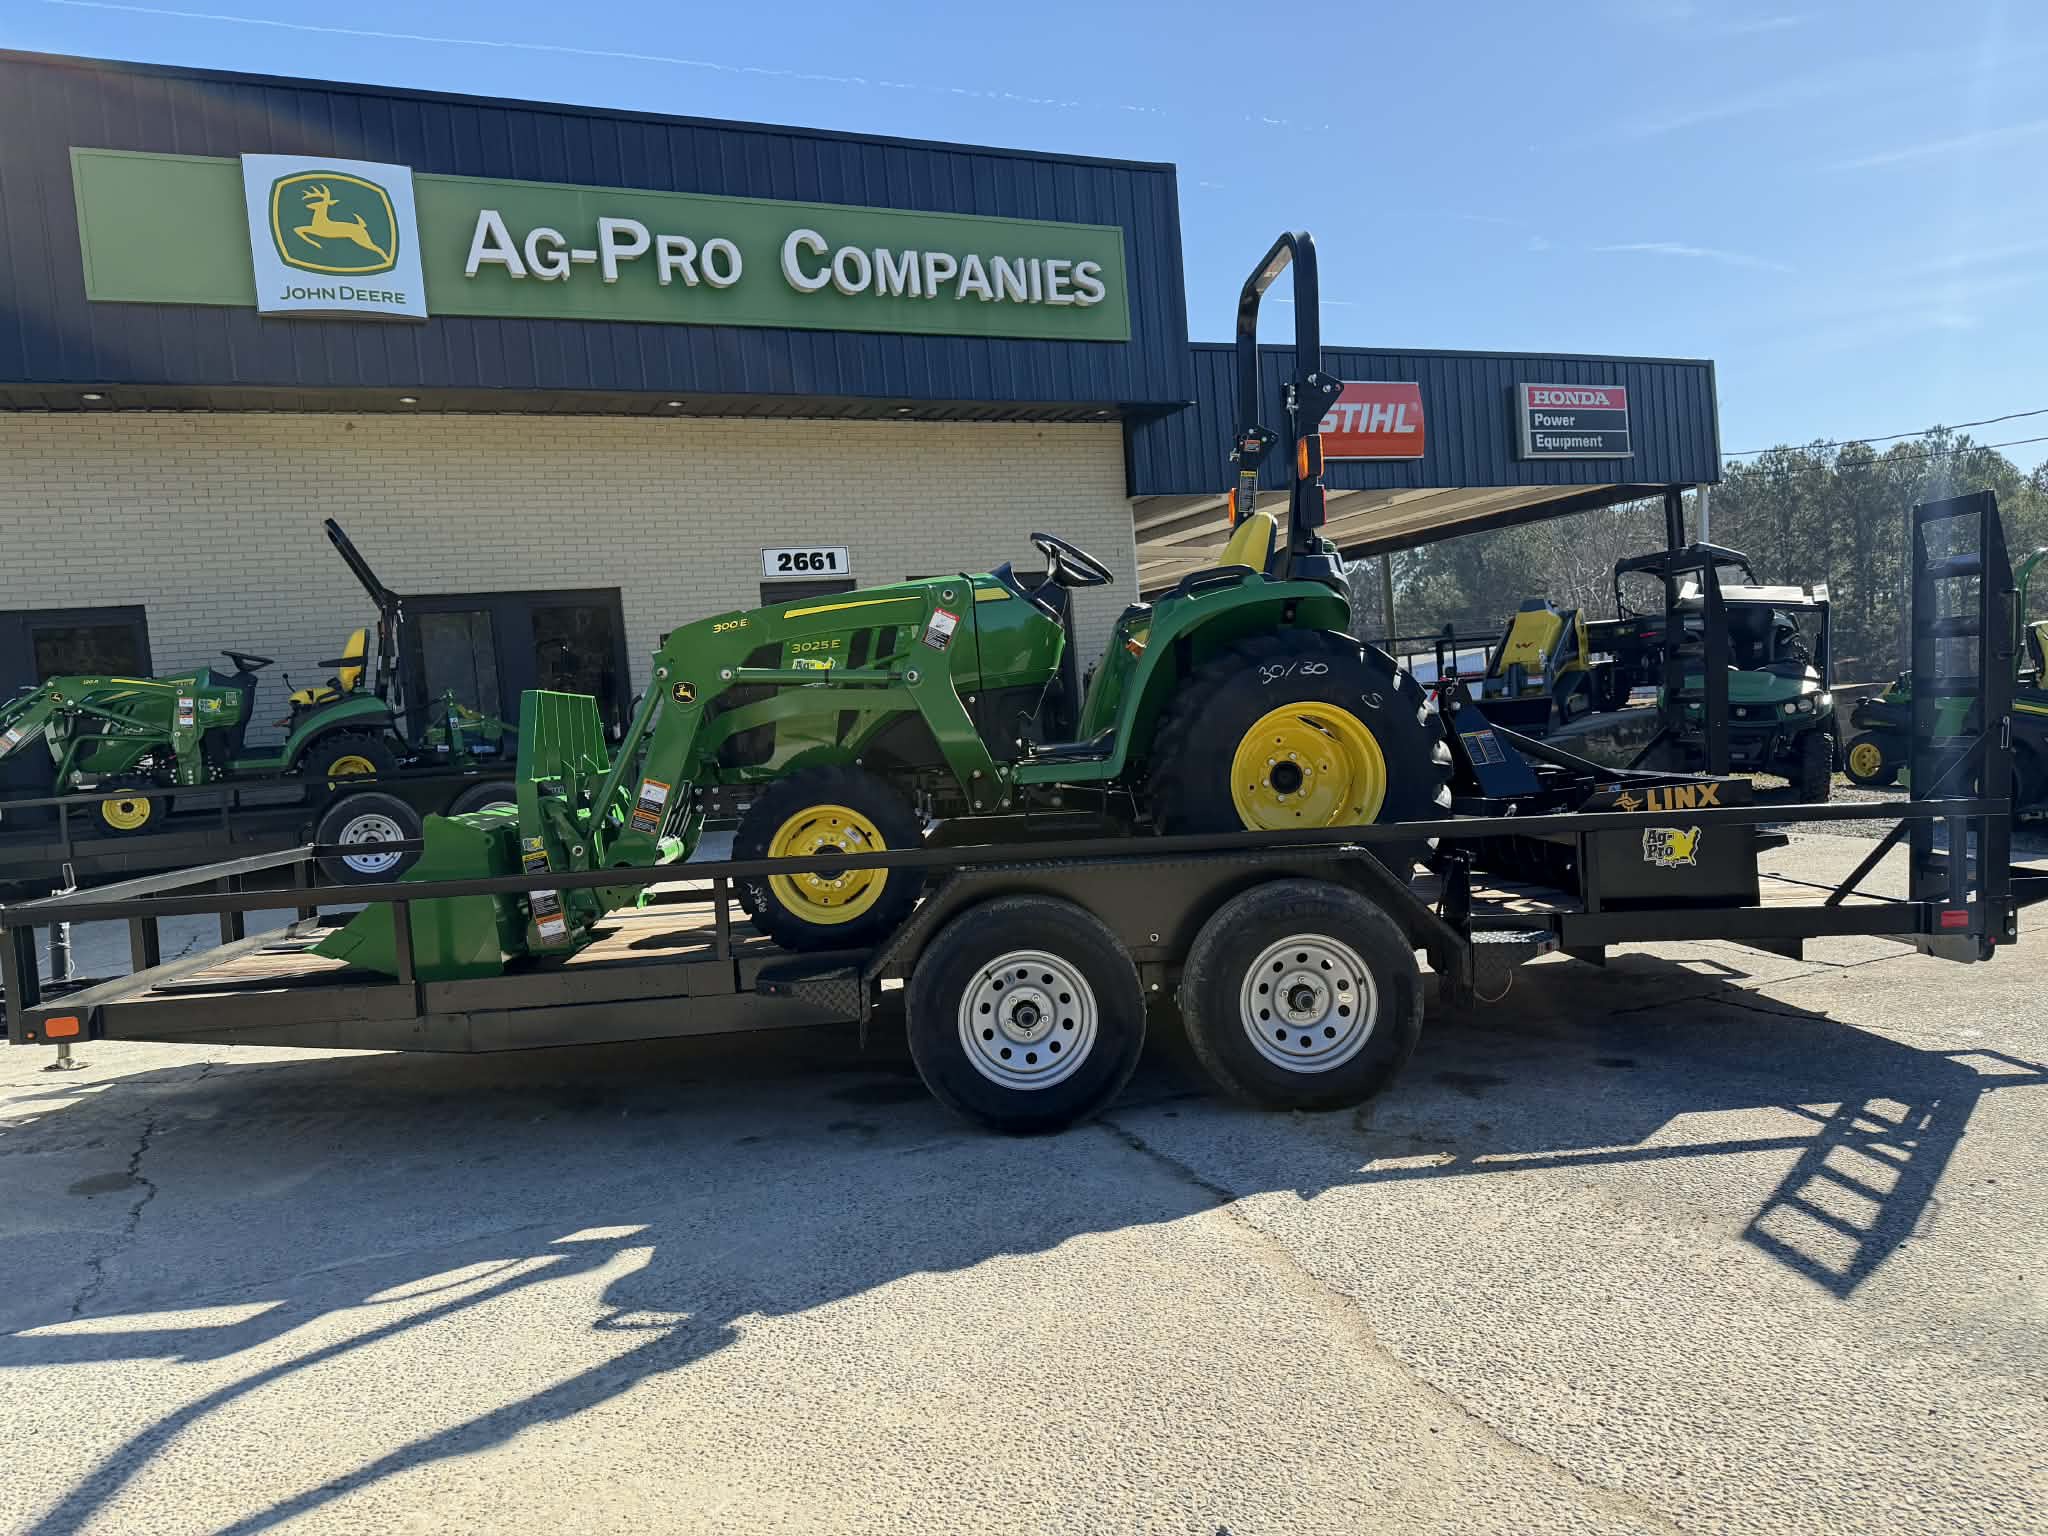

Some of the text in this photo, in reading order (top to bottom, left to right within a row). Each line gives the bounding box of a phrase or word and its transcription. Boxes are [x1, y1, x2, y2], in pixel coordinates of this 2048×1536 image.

[780, 228, 1105, 307] COMPANIES
[279, 285, 407, 305] JOHN DEERE
[1533, 390, 1611, 406] HONDA
[1318, 402, 1417, 433] STIHL
[1534, 413, 1576, 427] Power
[1536, 433, 1603, 450] Equipment
[777, 551, 837, 572] 2661
[791, 639, 842, 654] 3025E
[1647, 783, 1721, 811] LINX
